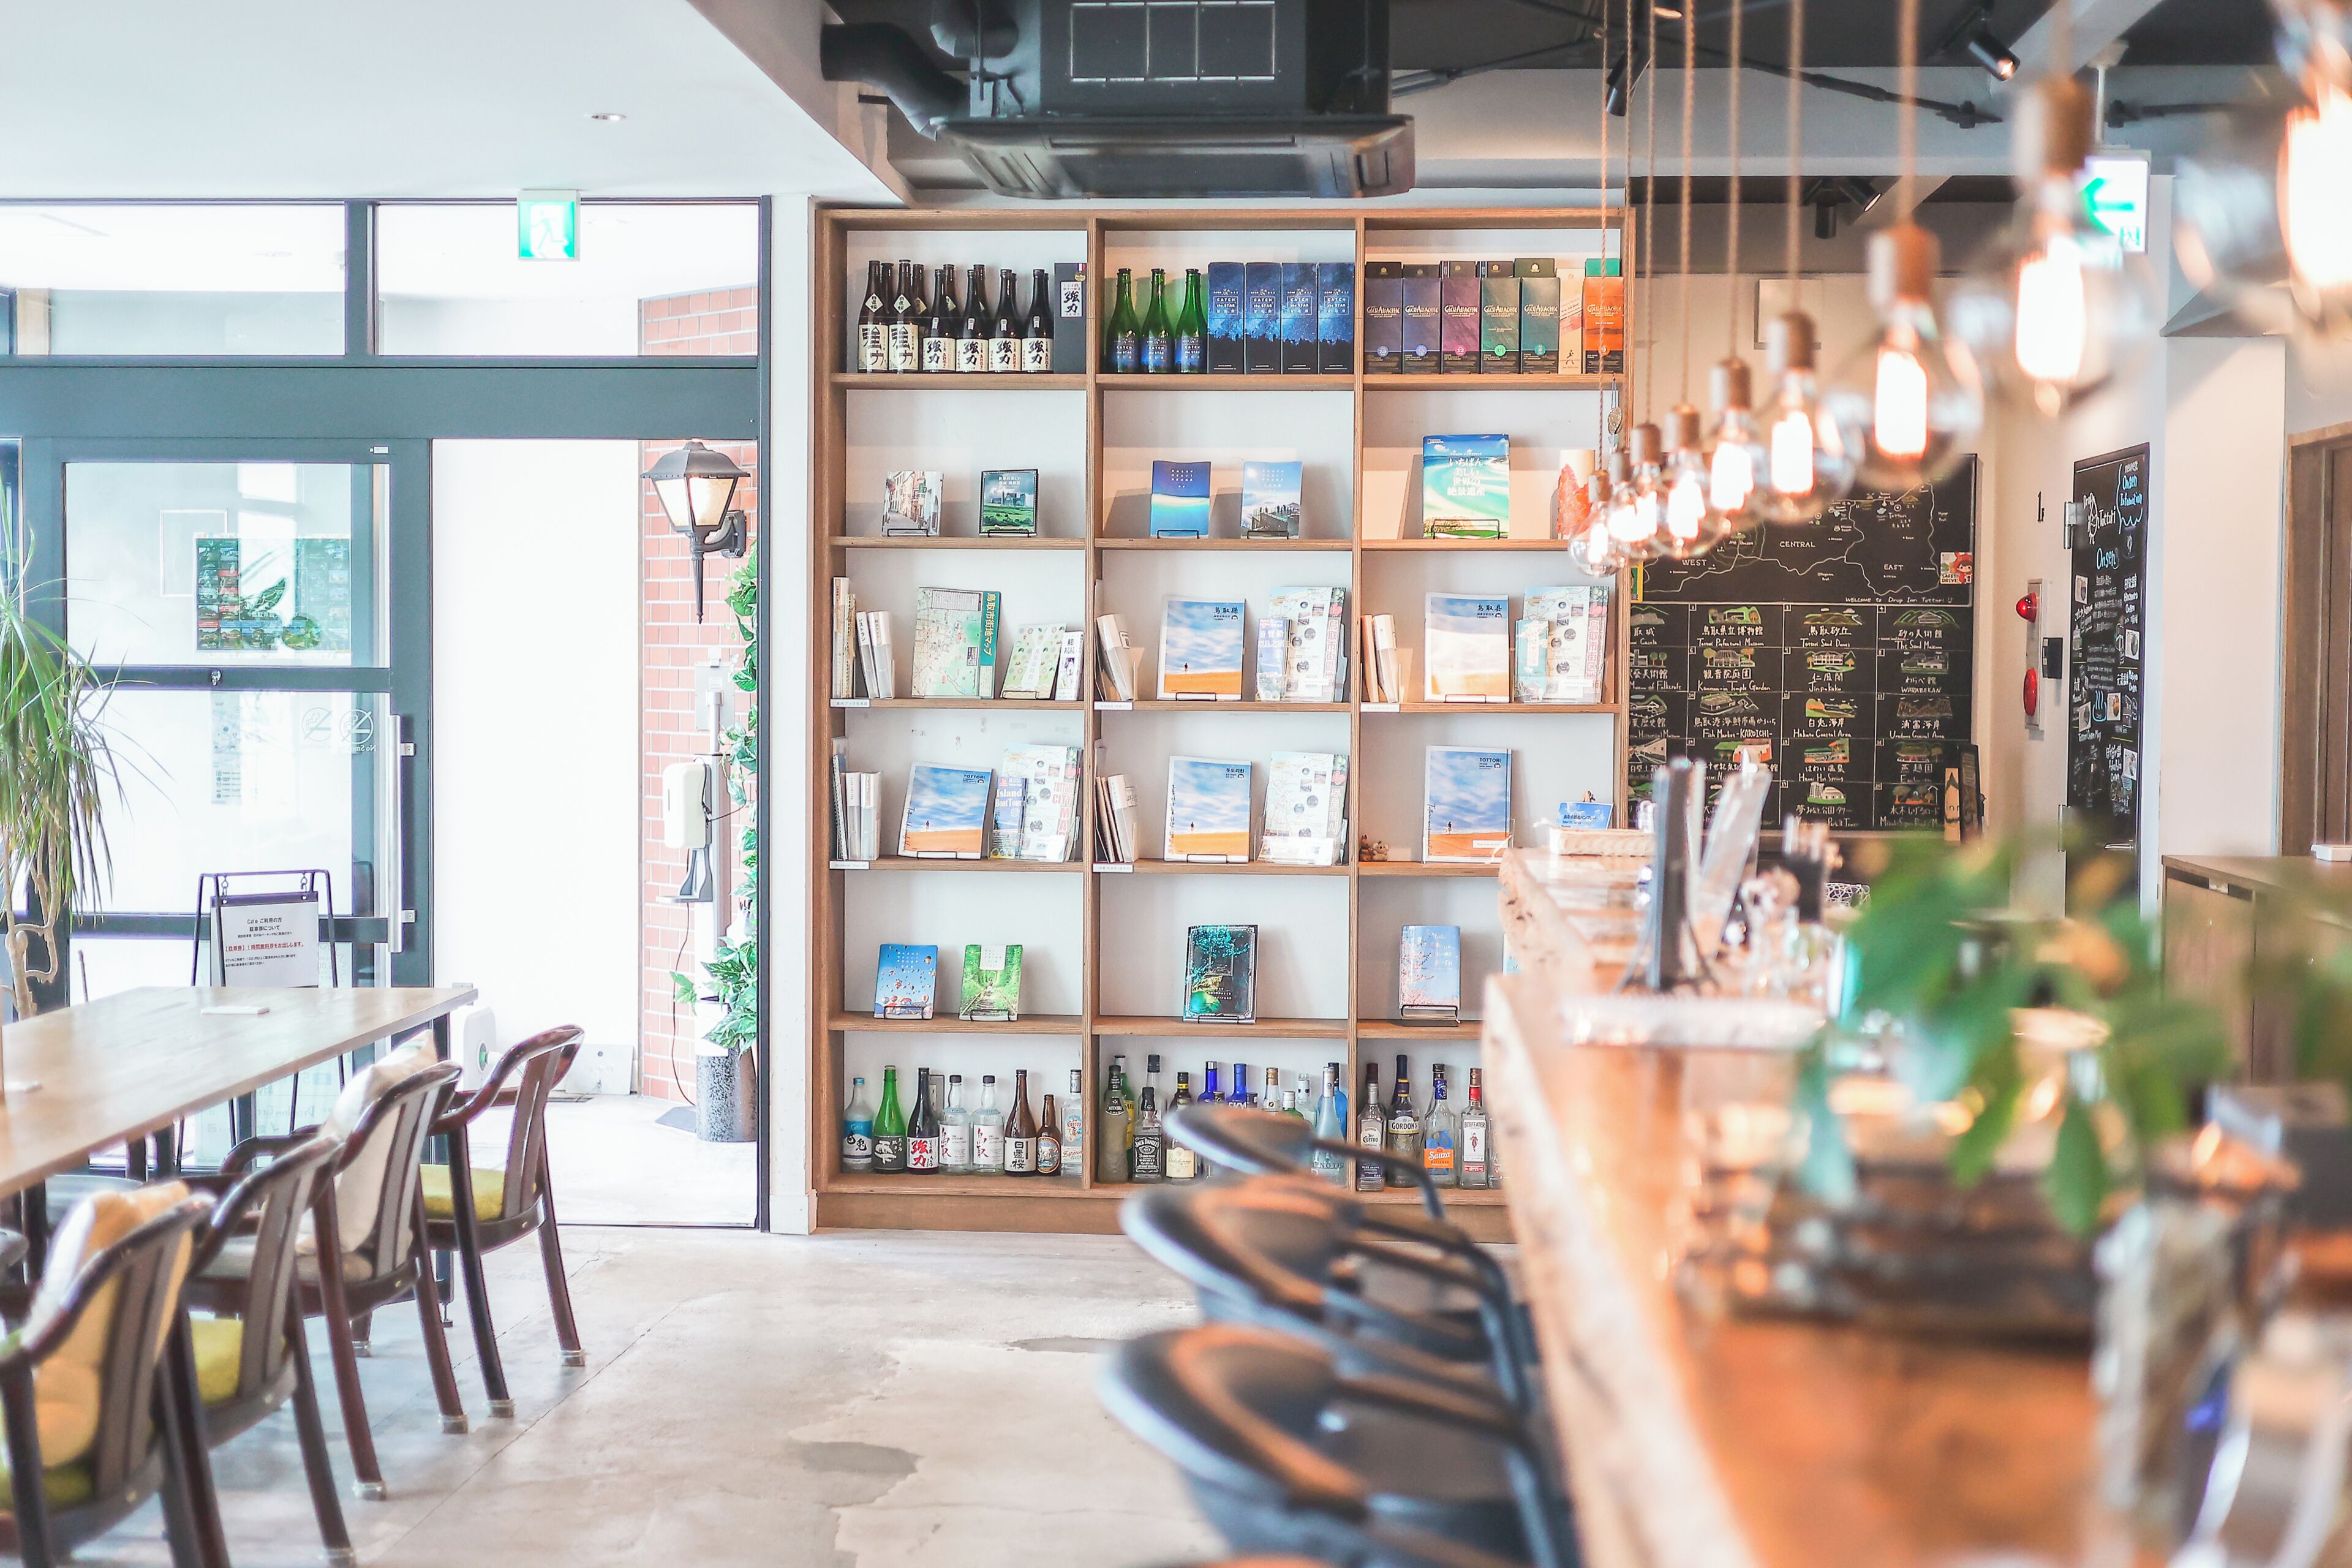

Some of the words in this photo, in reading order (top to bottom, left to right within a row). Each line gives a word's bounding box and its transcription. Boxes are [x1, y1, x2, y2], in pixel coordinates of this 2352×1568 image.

[1449, 457, 1483, 467] いちばん
[2122, 475, 2137, 490] Onsen
[2099, 505, 2116, 527] Tottori
[2097, 548, 2115, 570] Onsen
[982, 592, 997, 656] 鳥取市街地マップ
[1702, 625, 1763, 636] 鳥取県立博物館
[1809, 626, 1852, 636] 鳥取砂丘
[1894, 641, 1907, 649] The
[1703, 668, 1751, 679] 観音院庭園
[1648, 682, 1654, 690] of
[1727, 680, 1747, 691] Temple
[1749, 680, 1771, 691] Garden
[1694, 717, 1776, 727] 鳥取港海鮮市場かろいち
[1809, 718, 1844, 728] 白兎海岸
[1902, 720, 1939, 729] 浦富海岸
[1703, 729, 1715, 737] Fish
[1793, 729, 1814, 737] Hakuto
[1805, 764, 1845, 773] はわい温泉
[1817, 772, 1826, 782] Hot
[996, 789, 1022, 797] Island
[1052, 794, 1071, 804] CITY
[911, 1140, 929, 1167] 強力
[1428, 1151, 1450, 1161] Sauza
